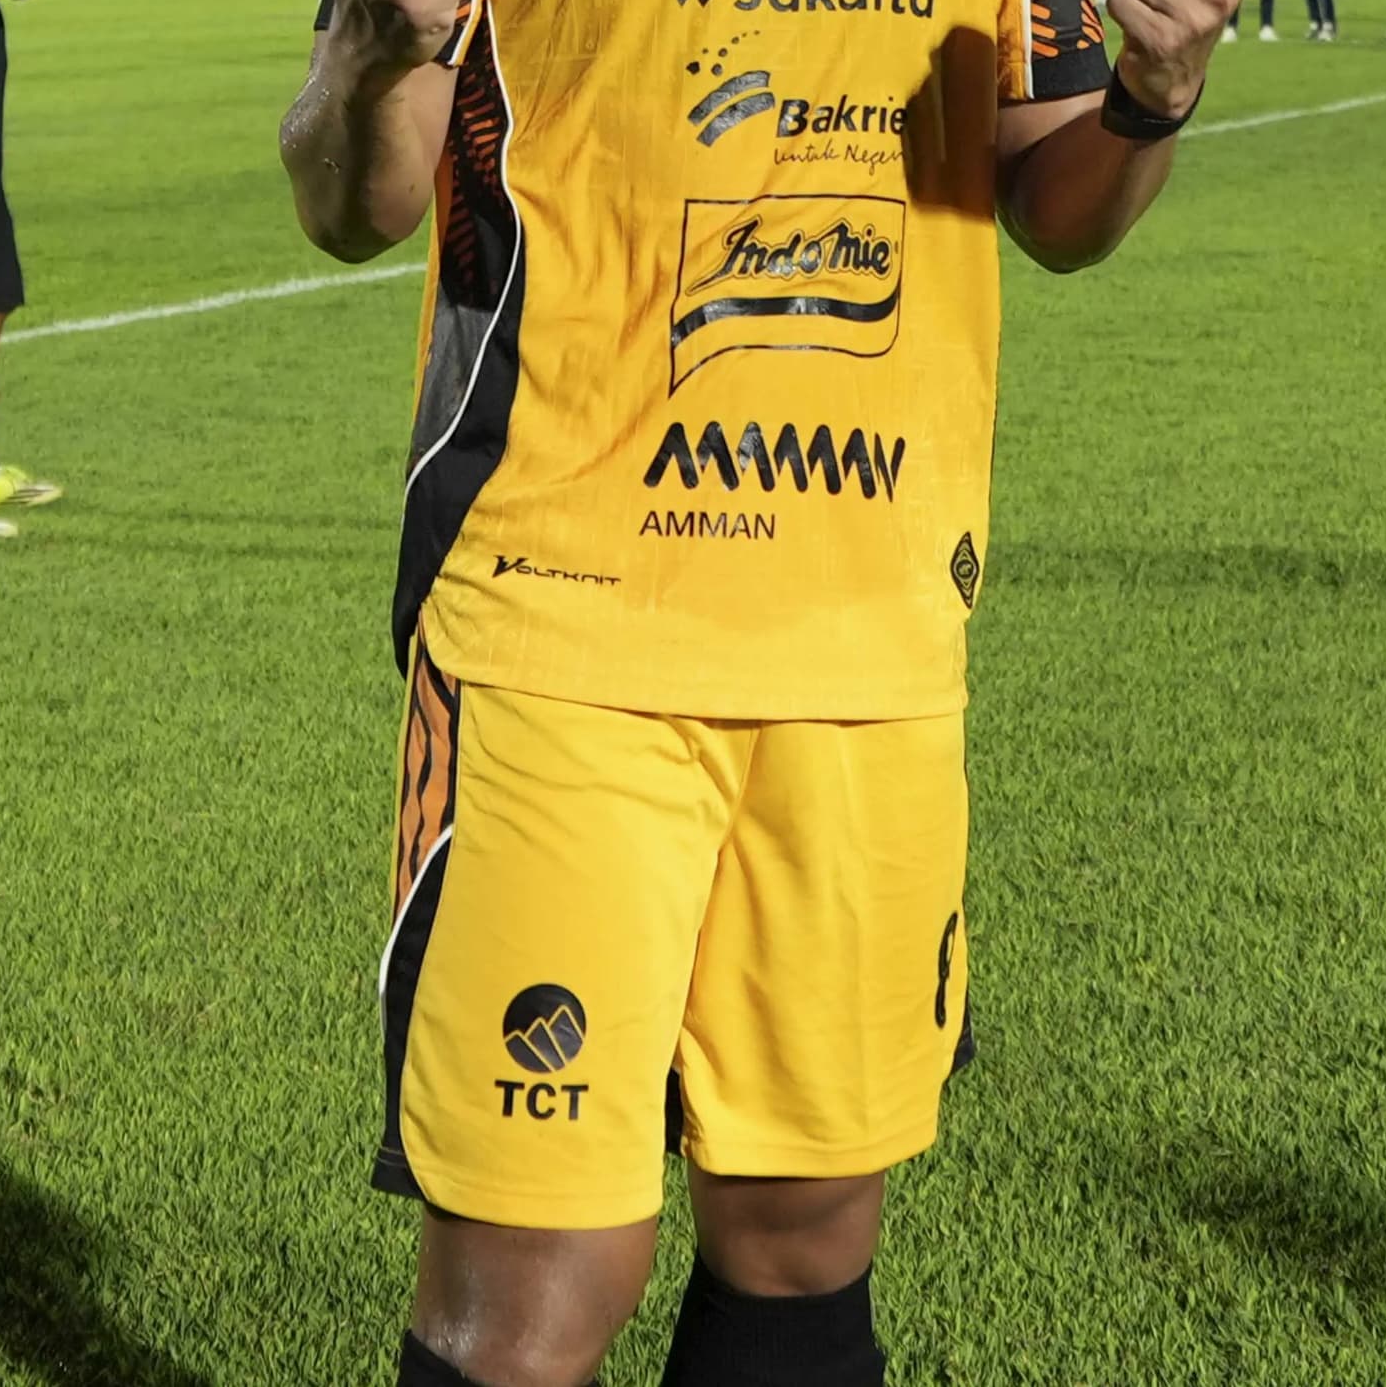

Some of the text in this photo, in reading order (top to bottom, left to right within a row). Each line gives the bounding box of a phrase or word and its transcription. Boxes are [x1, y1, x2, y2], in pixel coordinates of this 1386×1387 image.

[776, 94, 909, 138] Bakrie
[844, 143, 906, 176] Neger
[639, 510, 776, 540] AMMAN
[494, 1079, 590, 1122] TCT
